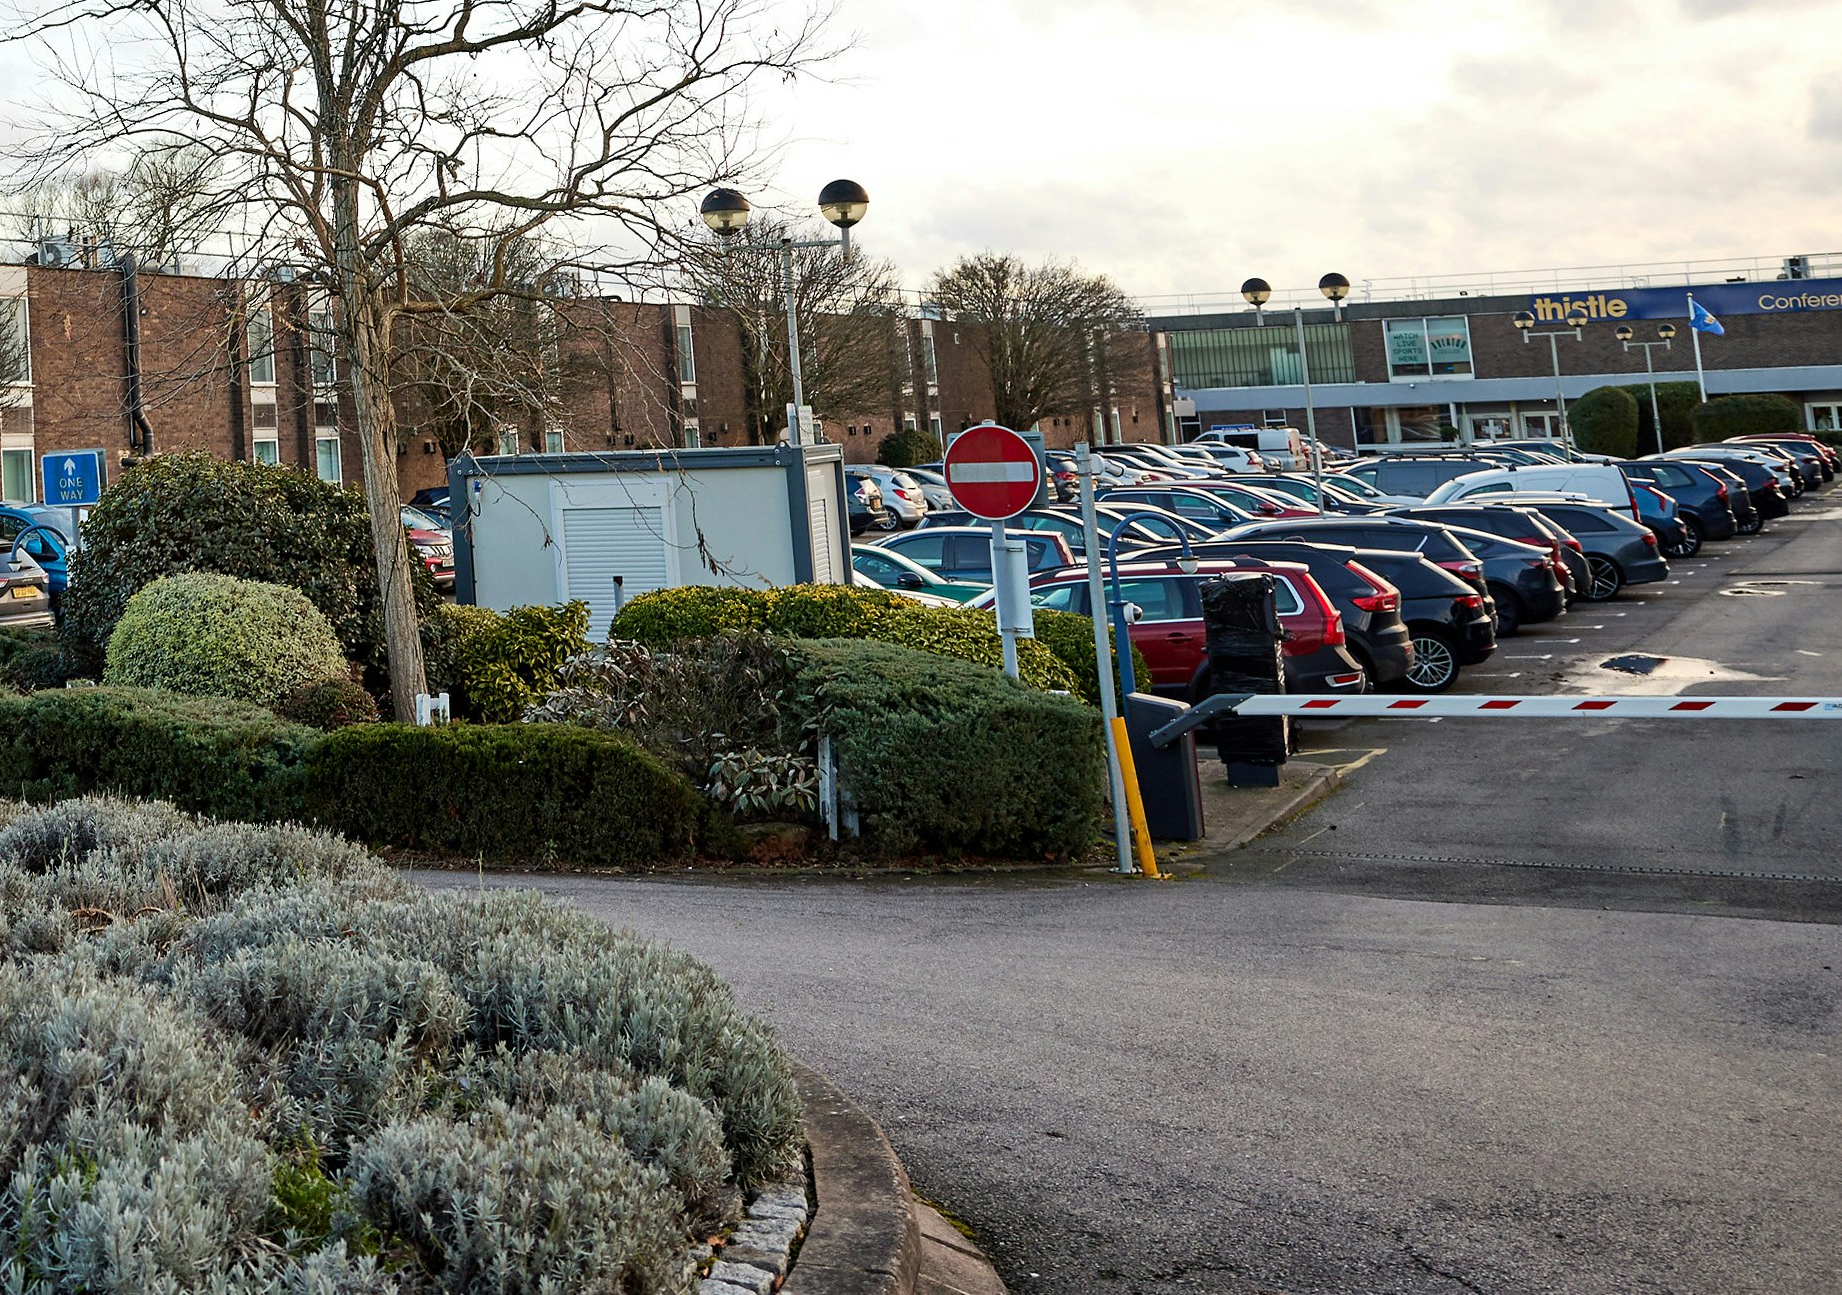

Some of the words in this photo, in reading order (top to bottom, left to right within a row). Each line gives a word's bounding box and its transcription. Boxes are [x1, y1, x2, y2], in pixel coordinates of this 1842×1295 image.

[1758, 292, 1842, 310] Confere
[59, 477, 83, 488] ONE
[60, 490, 83, 501] WAY
